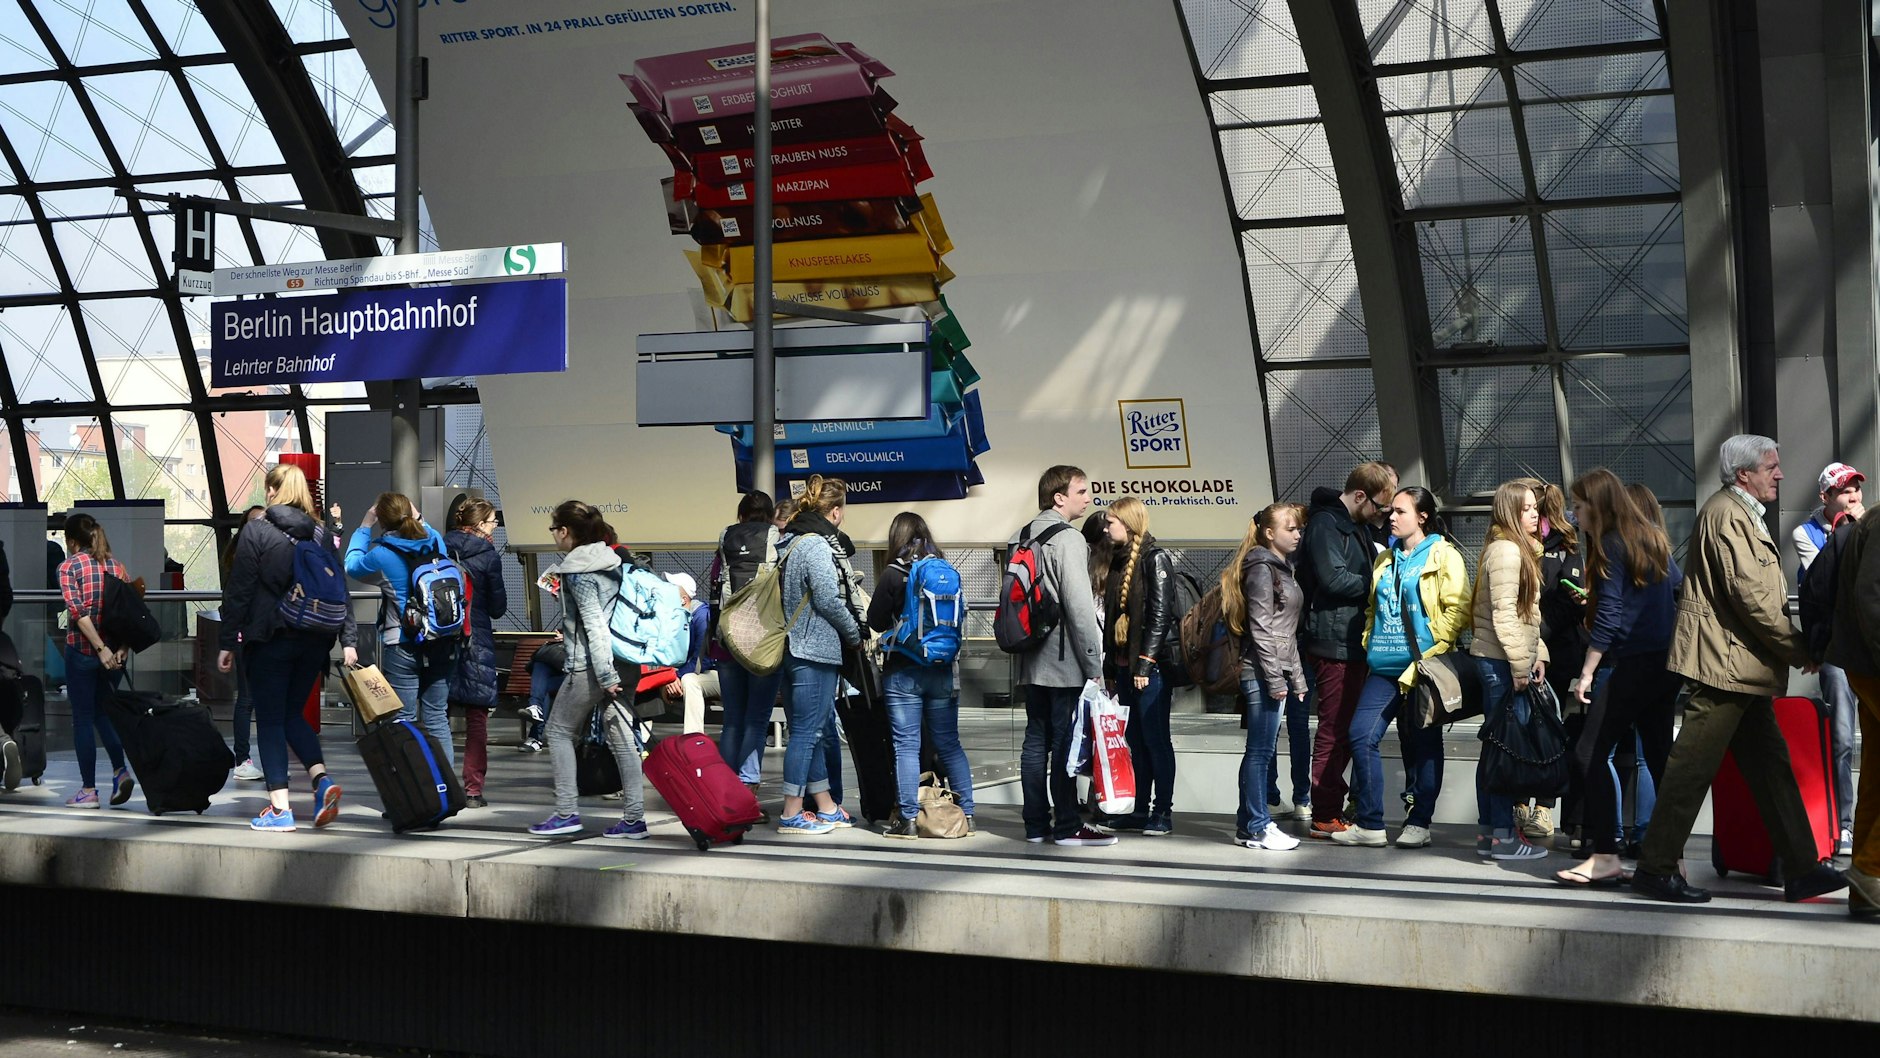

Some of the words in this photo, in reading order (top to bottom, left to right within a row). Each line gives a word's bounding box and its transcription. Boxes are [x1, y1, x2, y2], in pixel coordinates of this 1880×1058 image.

[440, 30, 479, 44] RITTER
[480, 25, 525, 40] SPORT.
[526, 22, 542, 34] IN
[544, 20, 562, 32] 24
[563, 15, 604, 31] PRALL
[605, 7, 676, 25] GEFÜLLTEN
[679, 1, 737, 17] SORTEN.
[770, 83, 813, 99] OGHURT
[818, 146, 848, 159] NUSS
[776, 179, 829, 193] MARZIPAN
[186, 208, 211, 261] H
[438, 253, 462, 265] Messe
[464, 251, 488, 263] Berlin
[789, 253, 872, 268] KNUSPERFLAKES
[230, 270, 245, 280] Der
[245, 269, 281, 279] schnellste
[282, 266, 300, 278] Weg
[301, 268, 314, 276] zur
[315, 264, 339, 274] Messe
[340, 262, 363, 273] Berlin
[314, 276, 349, 287] Richtung
[350, 273, 382, 287] Spandau
[384, 272, 397, 282] bis
[398, 268, 422, 281] S-Bhf.
[182, 275, 212, 293] Kurzzug
[290, 278, 301, 288] S5
[788, 291, 824, 303] WEISSE
[224, 309, 292, 341] Berlin
[301, 296, 478, 340] Hauptbahnhof
[224, 358, 273, 376] Lehrter
[276, 353, 336, 374] Bahnhof
[811, 421, 874, 433] ALPENMILCH
[1127, 411, 1179, 437] Ritter
[1130, 438, 1181, 452] SPORT
[826, 451, 905, 463] EDEL-VOLLMILCH
[846, 480, 882, 493] NUGAT
[1091, 481, 1116, 494] DIE
[1121, 479, 1234, 494] SCHOKOLADE
[1162, 496, 1213, 506] Praktisch.
[1217, 495, 1238, 505] Gut.
